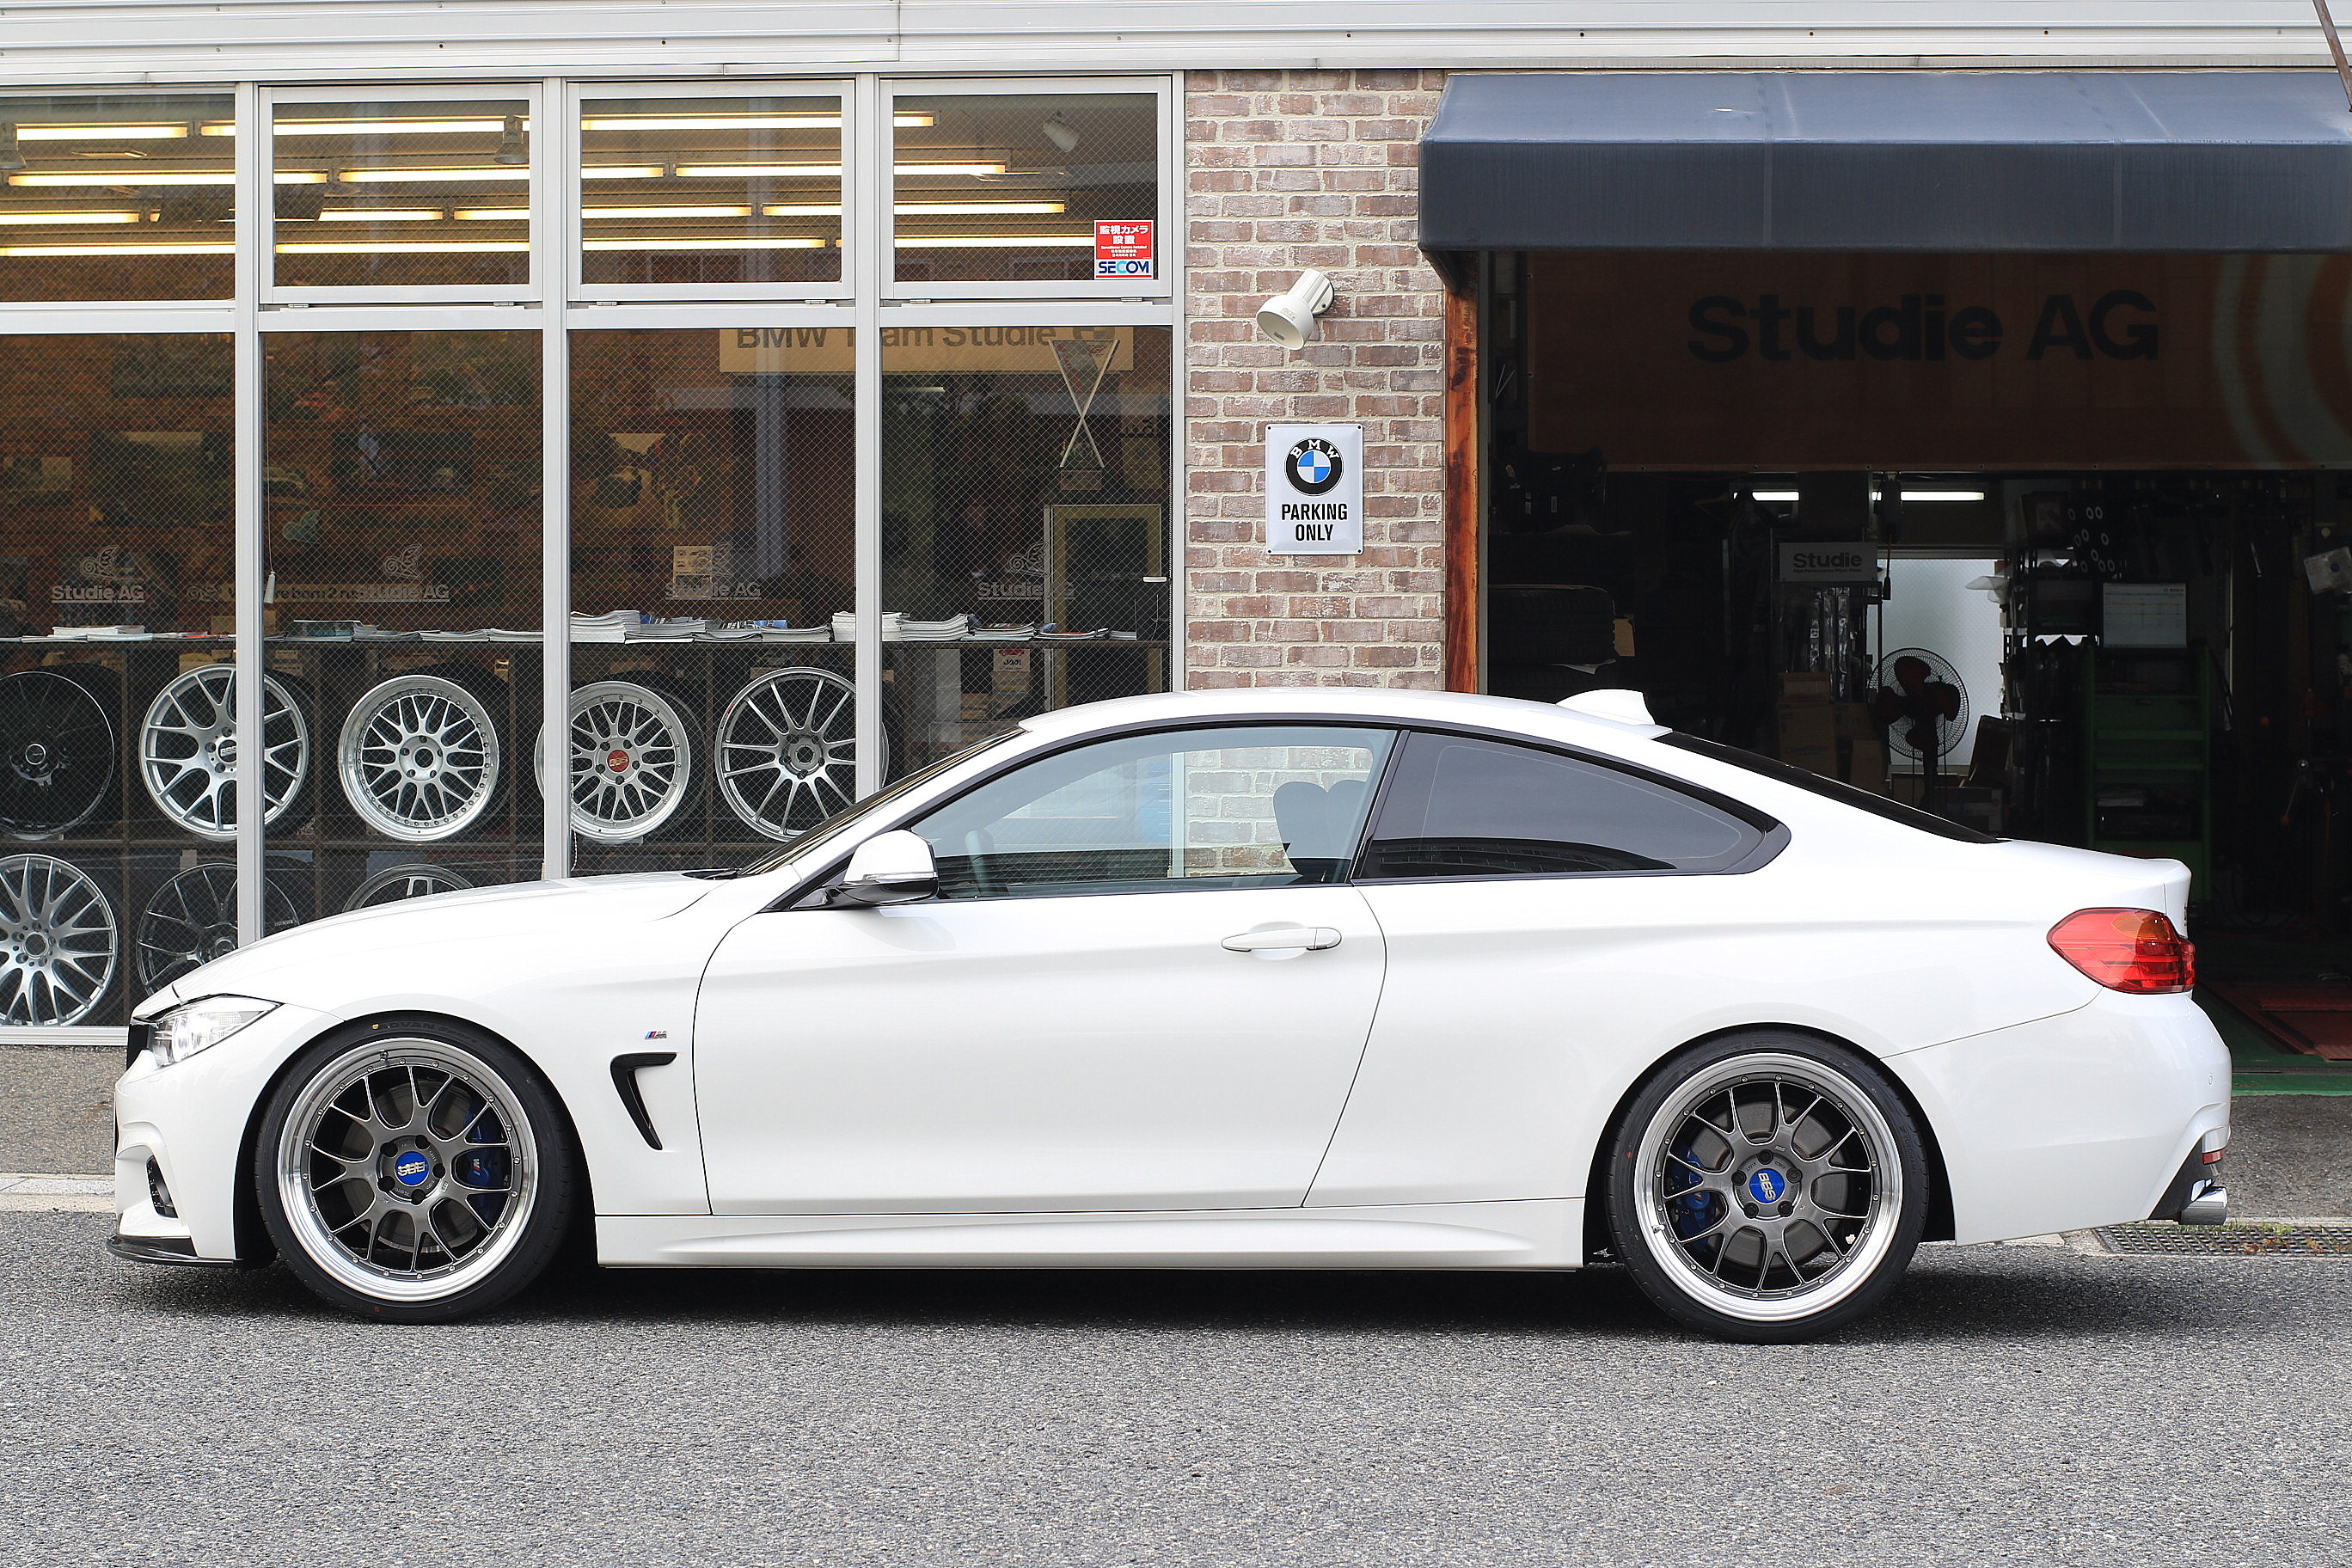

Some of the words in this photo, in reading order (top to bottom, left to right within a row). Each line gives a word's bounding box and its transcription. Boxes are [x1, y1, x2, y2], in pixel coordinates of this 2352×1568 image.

[1099, 224, 1149, 235] 監視カメラ
[1112, 235, 1136, 245] 設置
[1098, 260, 1149, 274] SECOM
[1688, 292, 2003, 363] Studie
[2026, 289, 2159, 363] AG
[1290, 439, 1340, 459] BMW
[1281, 503, 1348, 521] PARKING
[1295, 524, 1334, 542] ONLY
[1793, 552, 1862, 568] Studie
[52, 585, 115, 601] Studie
[118, 585, 144, 600] AG
[423, 584, 450, 599] AG
[734, 582, 761, 597] AG
[977, 581, 1044, 597] Studie
[397, 1161, 426, 1177] BBS
[1758, 1172, 1777, 1201] BBS
